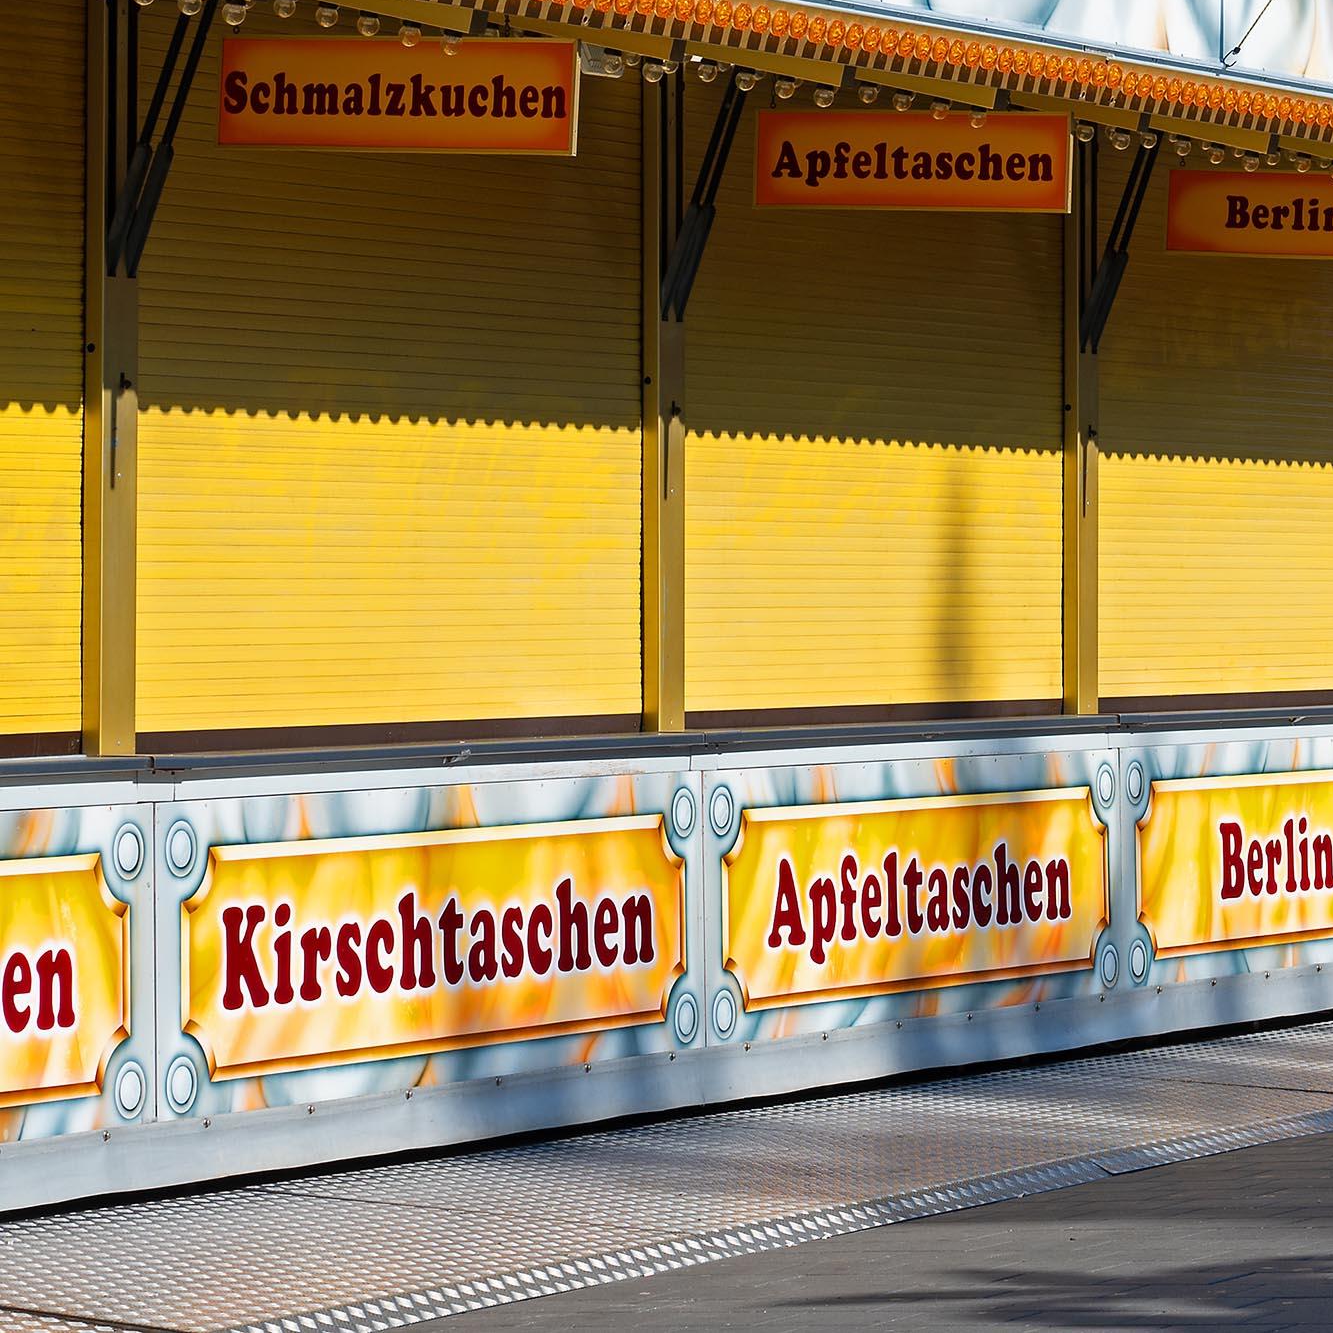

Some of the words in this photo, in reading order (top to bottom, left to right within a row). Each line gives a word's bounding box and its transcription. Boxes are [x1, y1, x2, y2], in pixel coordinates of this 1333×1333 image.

[223, 70, 569, 121] Schmalzkuchen
[771, 140, 1055, 188] Apfeltaschen
[221, 877, 655, 1011] Kirschtaschen
[767, 842, 1072, 965] Apfeltaschen
